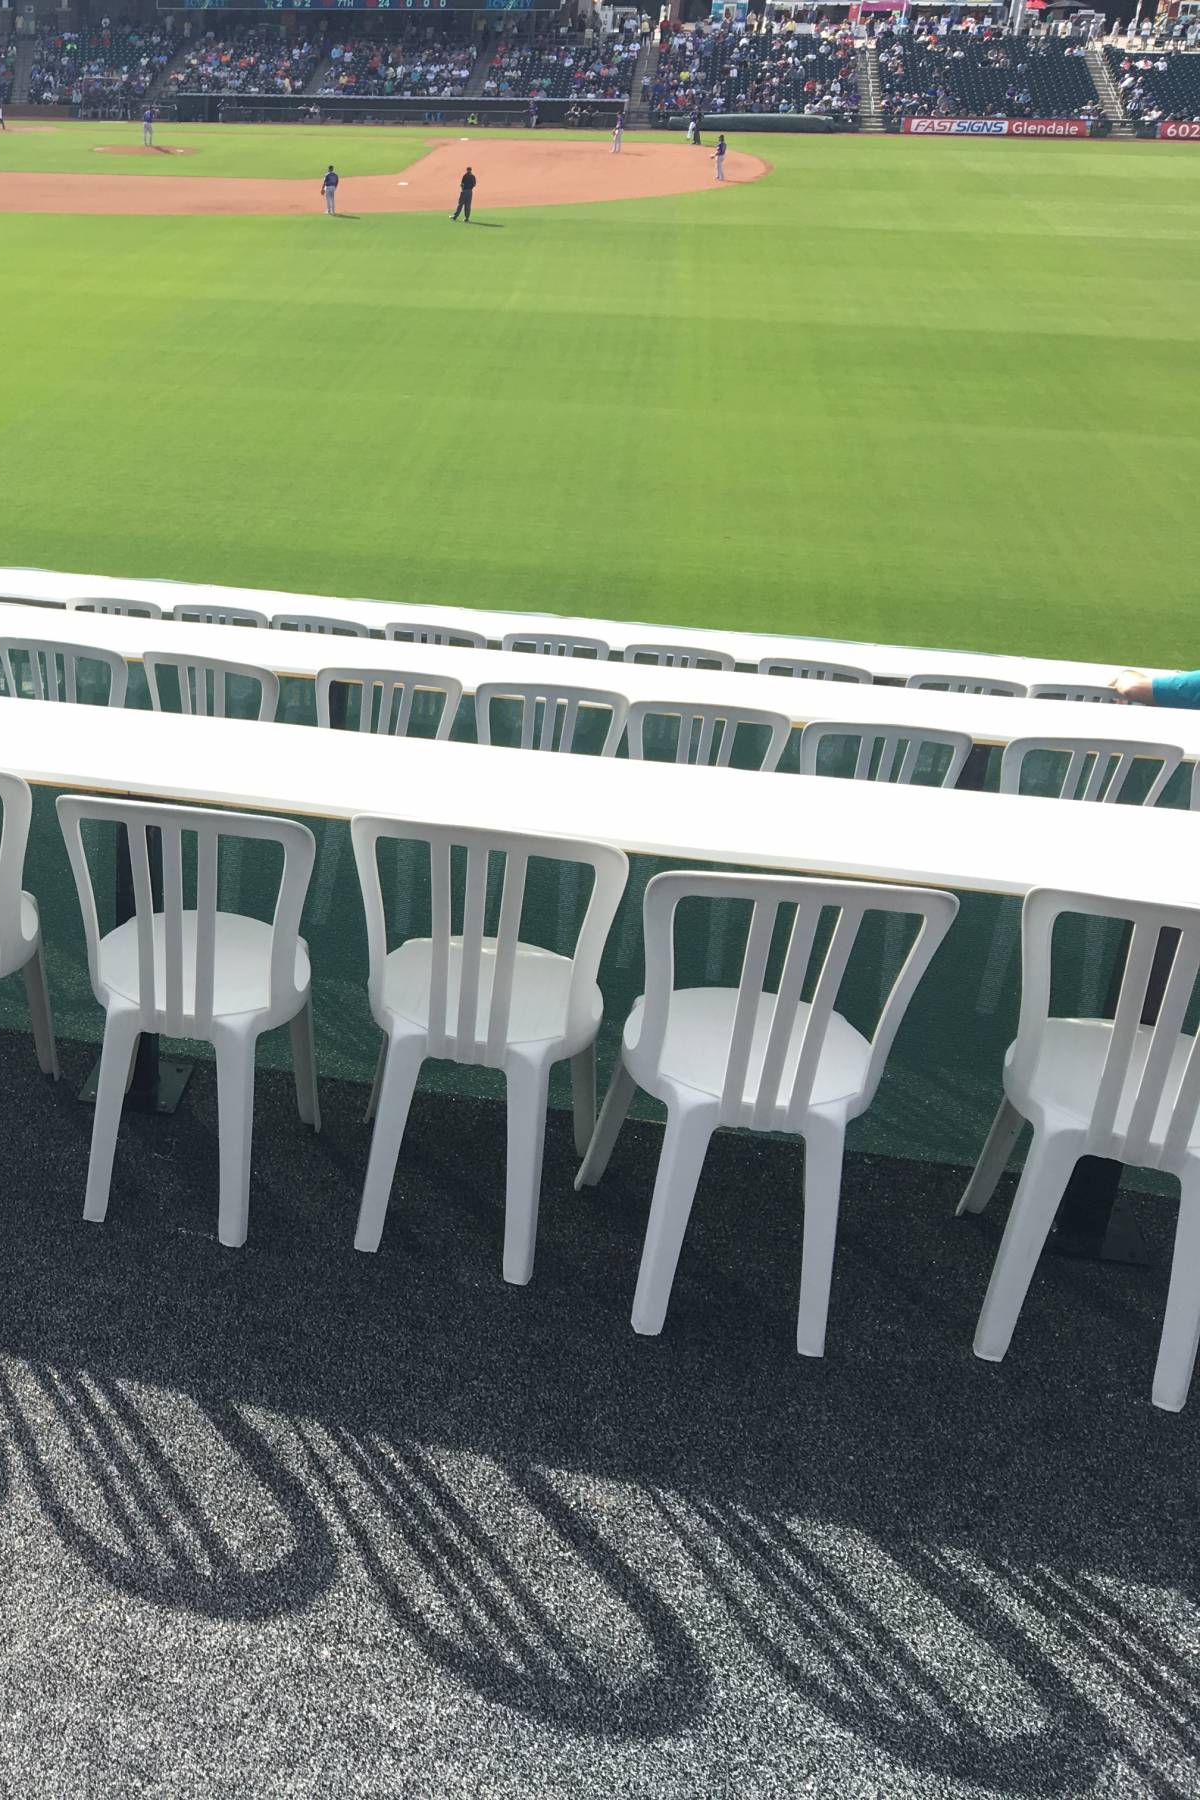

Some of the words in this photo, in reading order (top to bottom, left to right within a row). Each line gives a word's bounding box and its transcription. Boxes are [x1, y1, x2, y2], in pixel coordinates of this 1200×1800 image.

[915, 120, 1005, 133] FASTSIGNS
[1012, 121, 1079, 135] Glendale
[1166, 124, 1200, 137] 602
